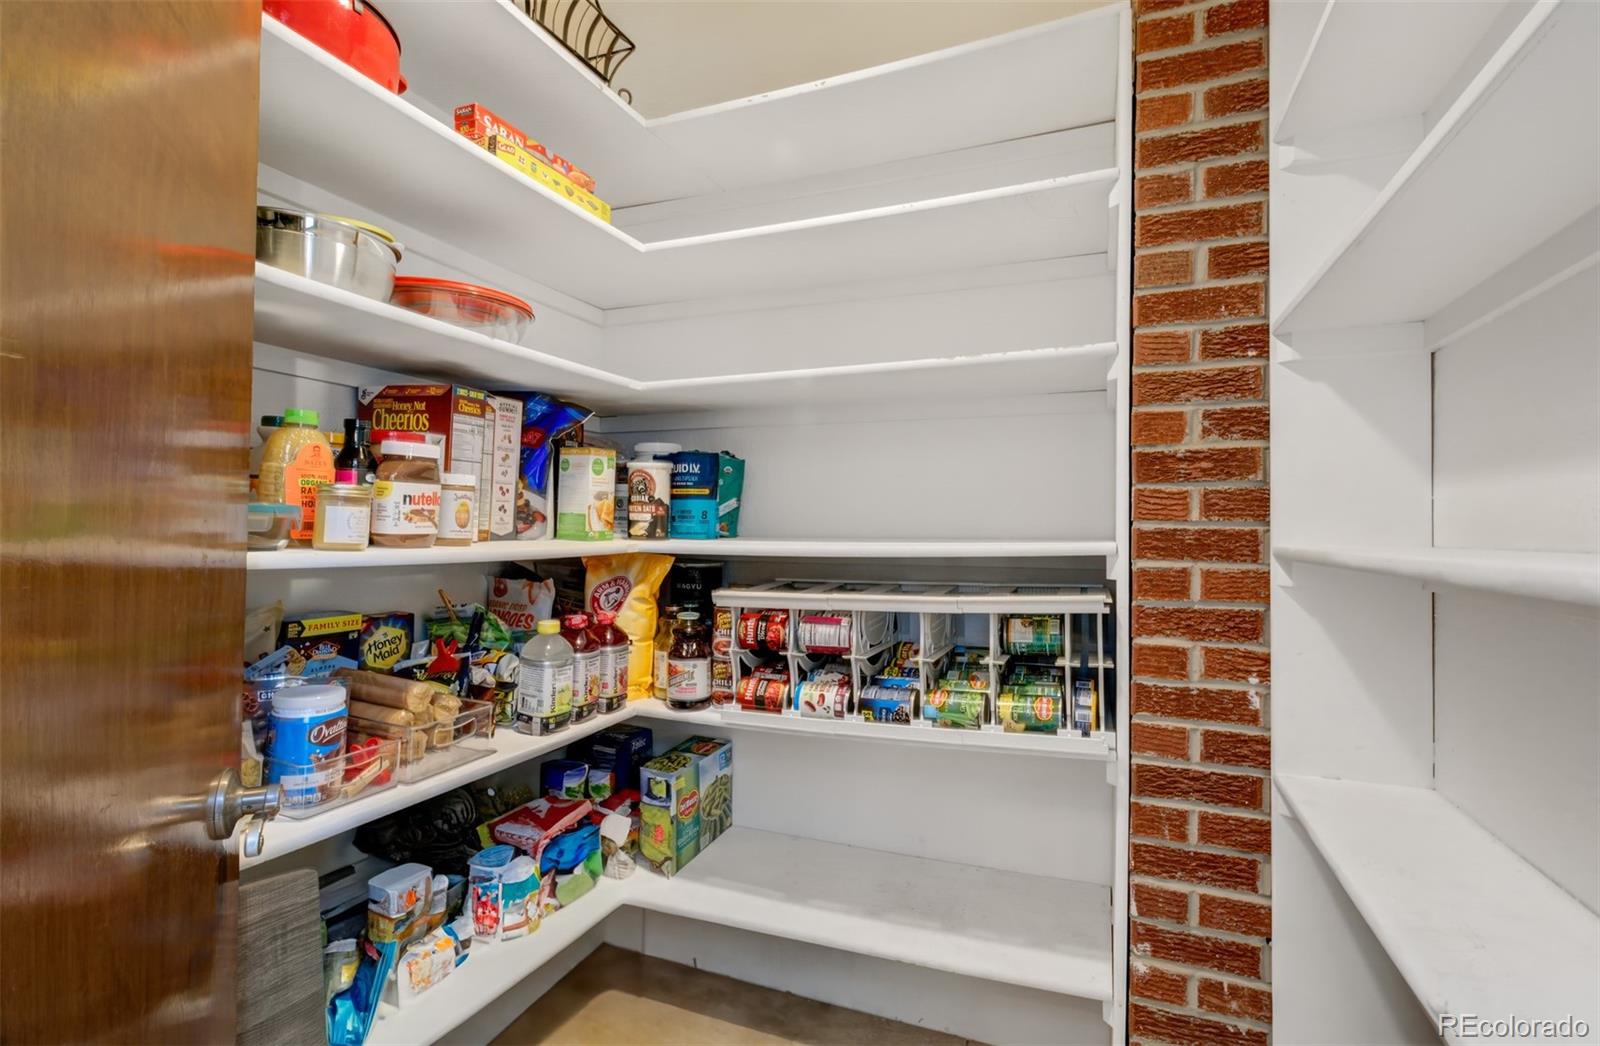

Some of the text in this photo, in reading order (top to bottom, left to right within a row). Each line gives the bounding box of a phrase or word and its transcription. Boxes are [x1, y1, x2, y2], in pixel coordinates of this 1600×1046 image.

[484, 115, 525, 149] SARAN
[392, 401, 412, 413] Honey
[413, 401, 426, 411] Nut
[372, 408, 430, 431] Cheerios
[701, 510, 708, 520] 8
[594, 582, 610, 599] ARM
[308, 621, 340, 632] FAMILY
[343, 619, 361, 628] SIZE
[367, 633, 403, 655] Honey
[373, 644, 400, 663] Maid
